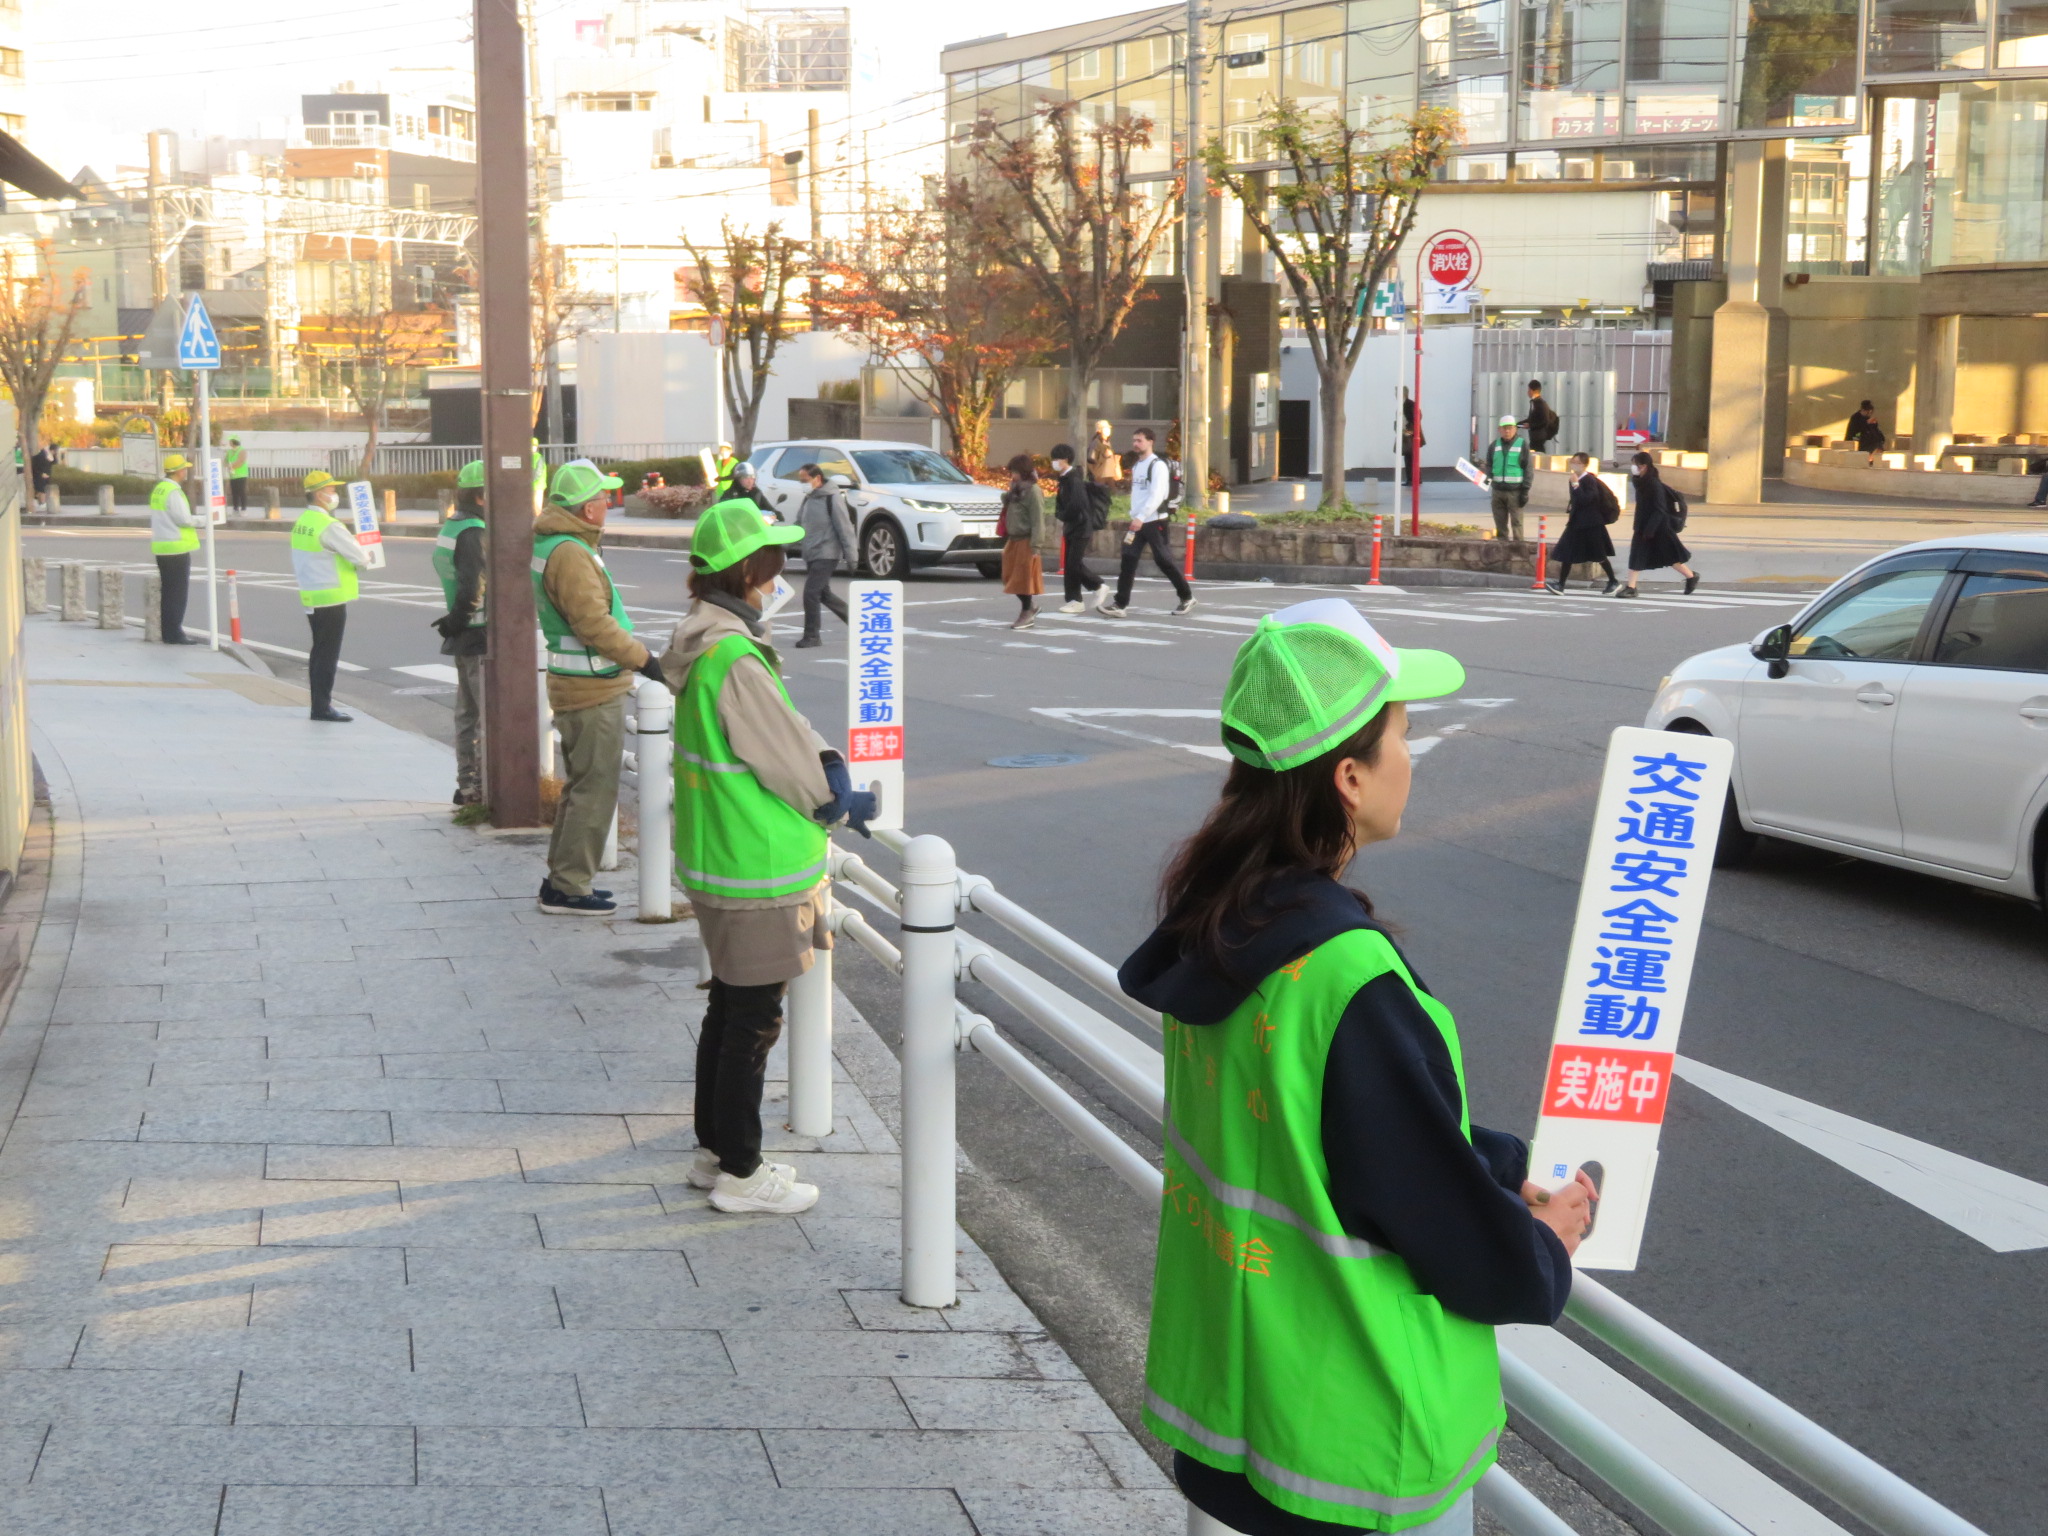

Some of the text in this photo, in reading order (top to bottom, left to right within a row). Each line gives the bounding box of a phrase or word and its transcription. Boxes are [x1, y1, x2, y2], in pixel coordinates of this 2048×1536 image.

[1431, 251, 1469, 272] 消火栓
[859, 590, 893, 723] 交通安全運動
[854, 731, 899, 758] 実施中
[1578, 752, 1708, 1041] 交通安全運動
[1553, 1055, 1660, 1114] 実施中
[1552, 1163, 1569, 1179] 岡
